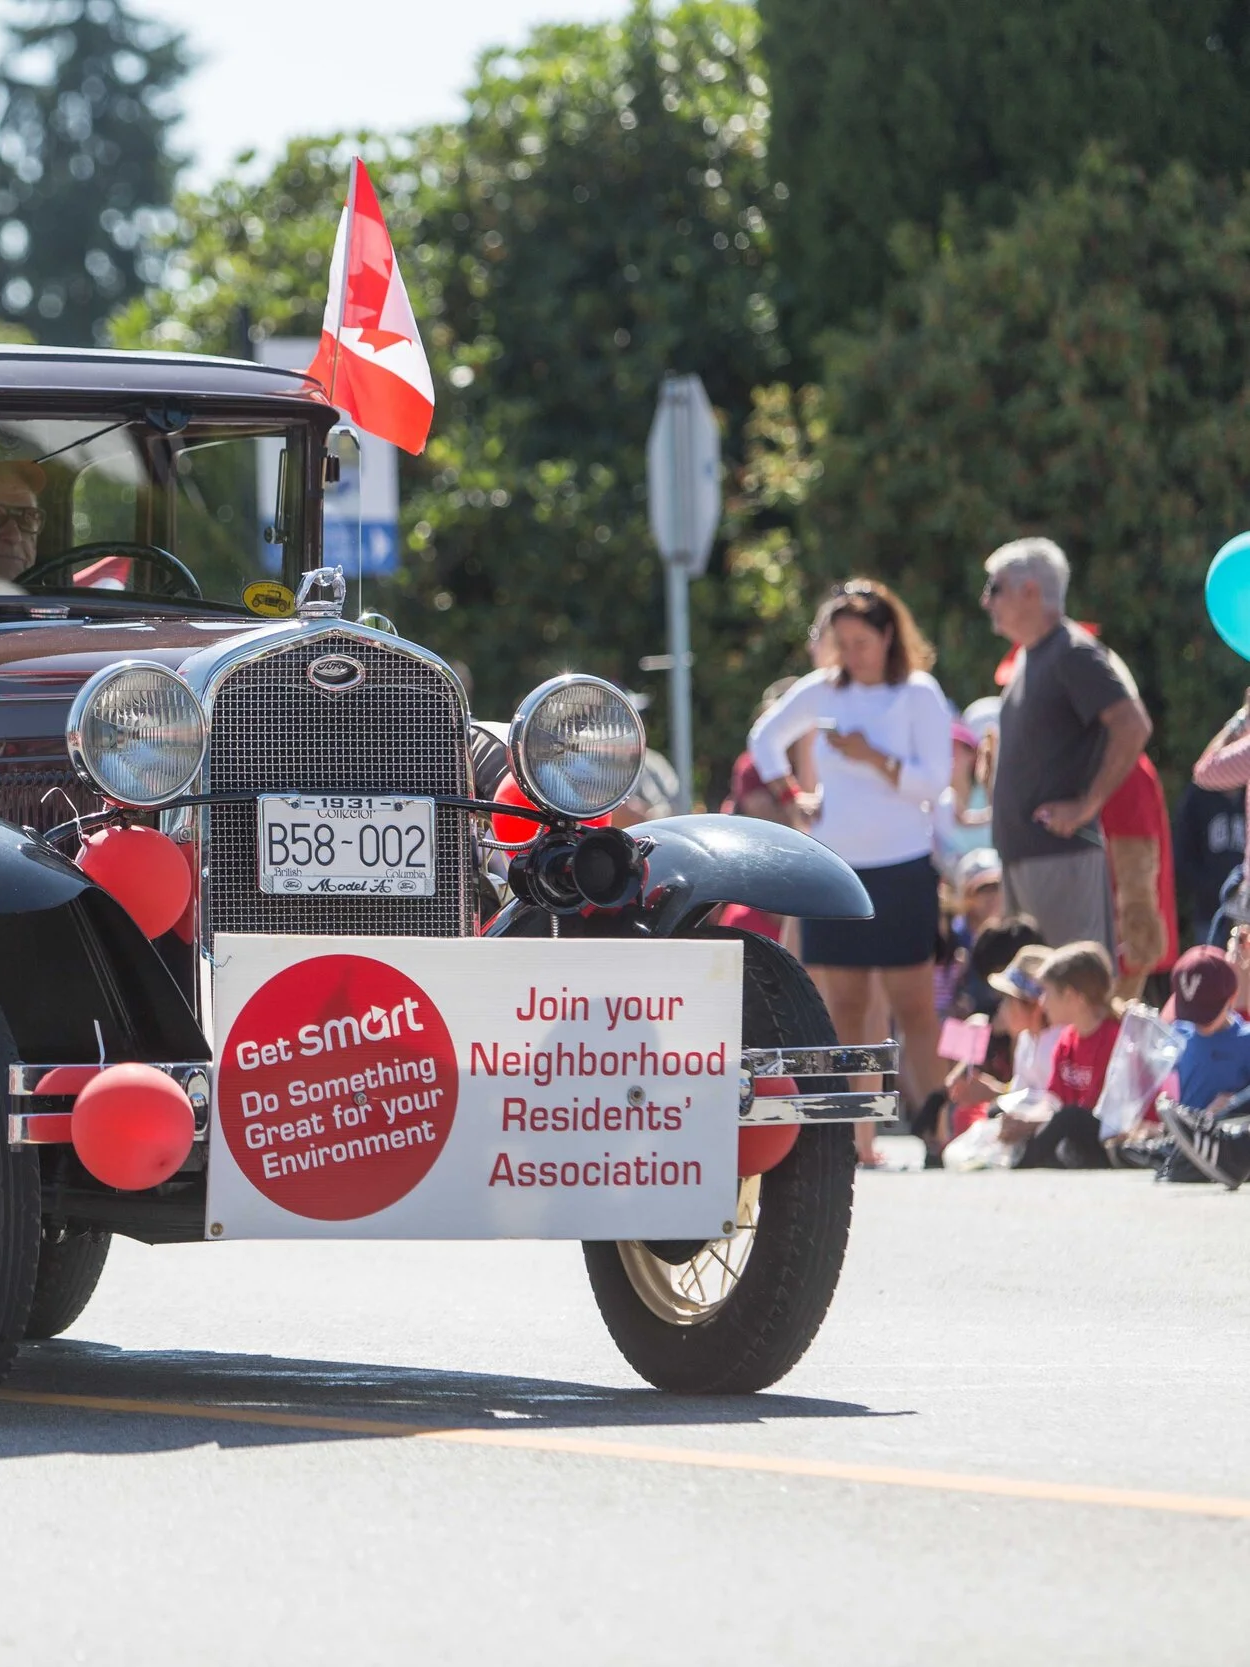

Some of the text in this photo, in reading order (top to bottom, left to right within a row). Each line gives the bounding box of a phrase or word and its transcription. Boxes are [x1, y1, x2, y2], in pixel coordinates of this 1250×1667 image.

[320, 797, 373, 809] 1931
[268, 822, 426, 868] B58-002
[274, 866, 427, 878] British Columbia
[307, 878, 367, 893] Model
[516, 986, 683, 1031] Join your
[236, 996, 424, 1071] Get smart
[241, 1055, 437, 1117] Do Something
[470, 1041, 726, 1087] Neighborhood
[244, 1087, 444, 1150] Great for your
[261, 1120, 437, 1180] Environment
[488, 1152, 702, 1187] Association
